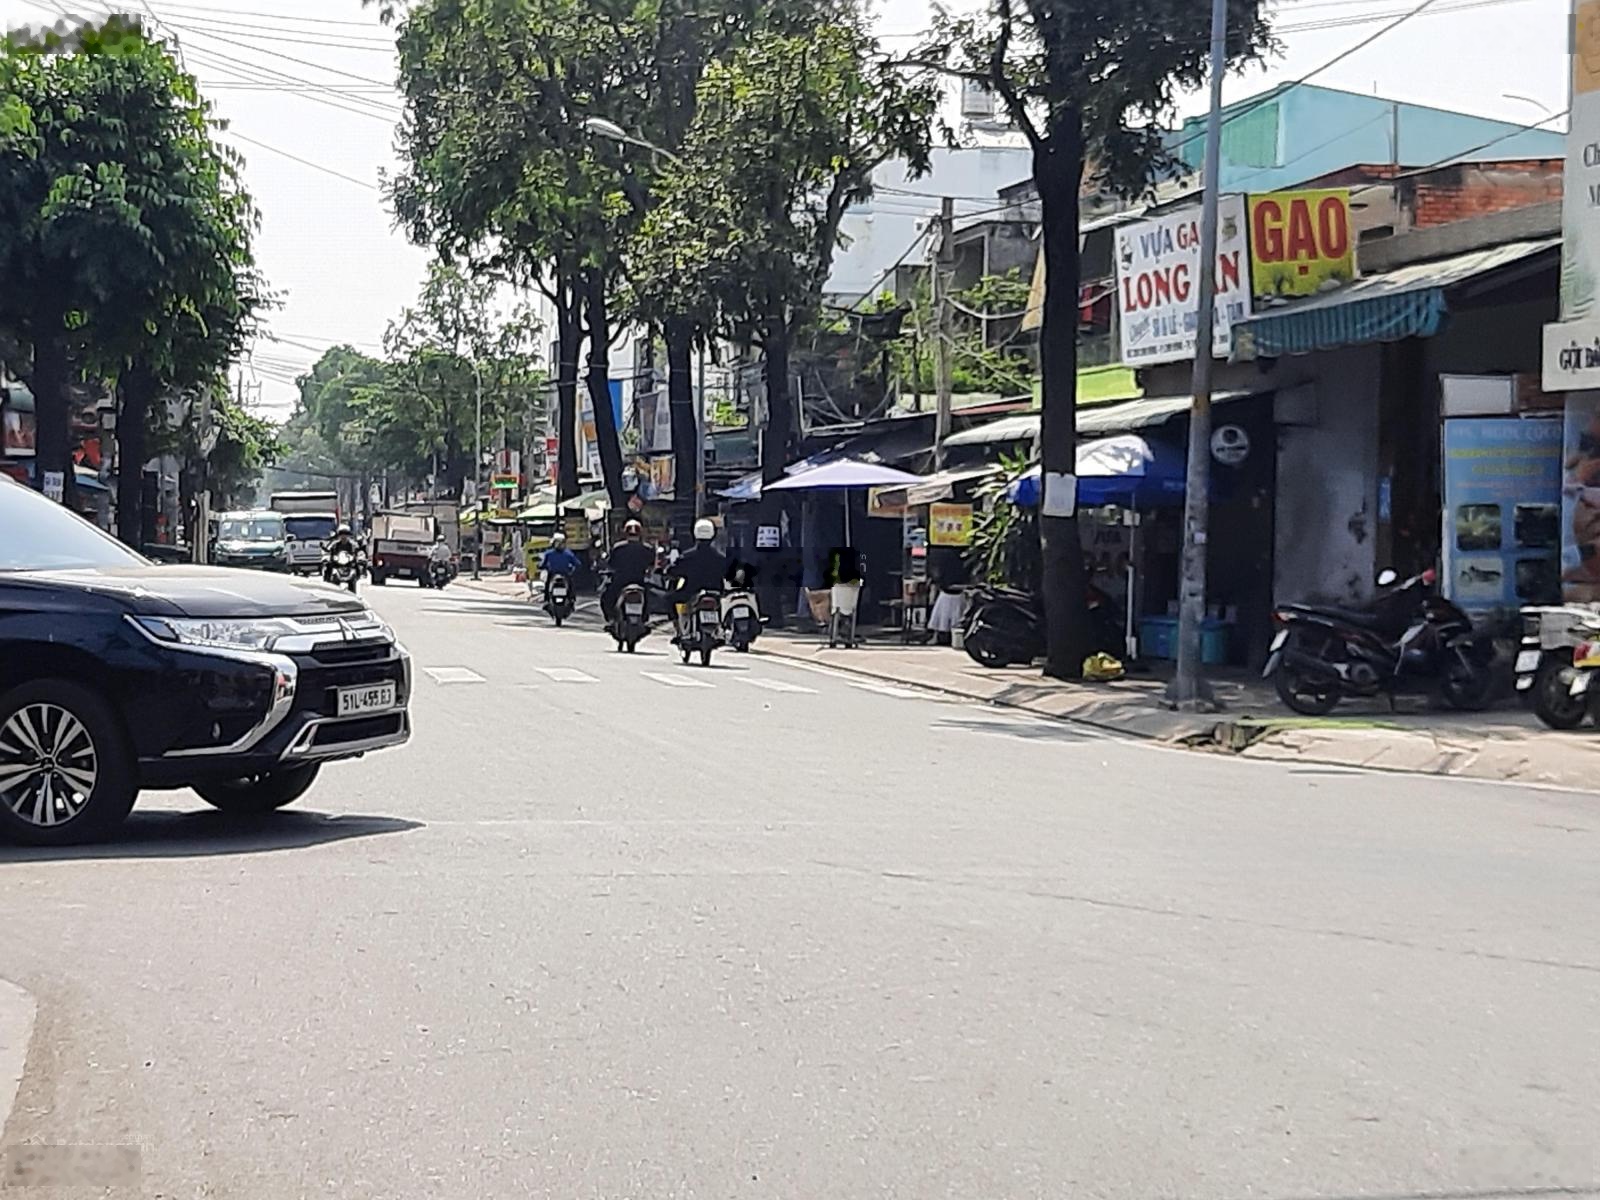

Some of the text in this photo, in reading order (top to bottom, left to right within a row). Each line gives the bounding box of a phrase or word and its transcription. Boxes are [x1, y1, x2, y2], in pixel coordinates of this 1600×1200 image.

[1140, 221, 1200, 264] VỰA GẠ
[1253, 197, 1347, 275] GẠO
[1123, 264, 1191, 312] LONG
